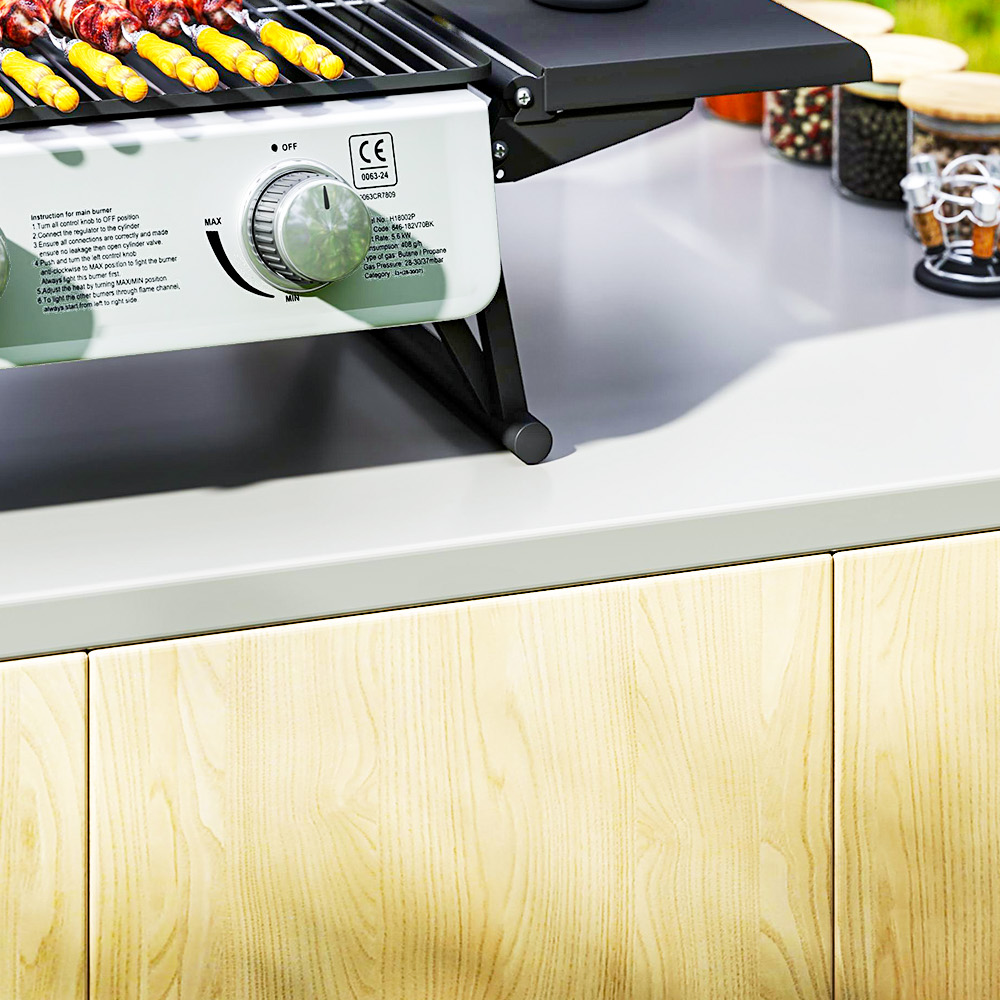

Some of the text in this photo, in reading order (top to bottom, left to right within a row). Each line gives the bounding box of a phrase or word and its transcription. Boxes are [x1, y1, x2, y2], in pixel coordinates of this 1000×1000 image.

[282, 143, 297, 151] OFF
[361, 172, 388, 181] 0063-24
[31, 212, 64, 220] Instruction
[117, 214, 139, 222] position
[205, 217, 221, 226] MAX
[74, 227, 98, 235] regulator
[118, 223, 139, 231] cylinder
[69, 236, 102, 244] connections
[69, 246, 92, 254] leakage
[123, 241, 144, 249] cylinder
[369, 243, 399, 251] nsumption:
[102, 252, 121, 260] control
[364, 254, 376, 262] ype
[398, 250, 418, 258] Butane
[105, 261, 127, 269] position
[145, 276, 167, 284] position
[93, 290, 114, 298] burners
[116, 288, 137, 296] through
[285, 294, 300, 302] MIN
